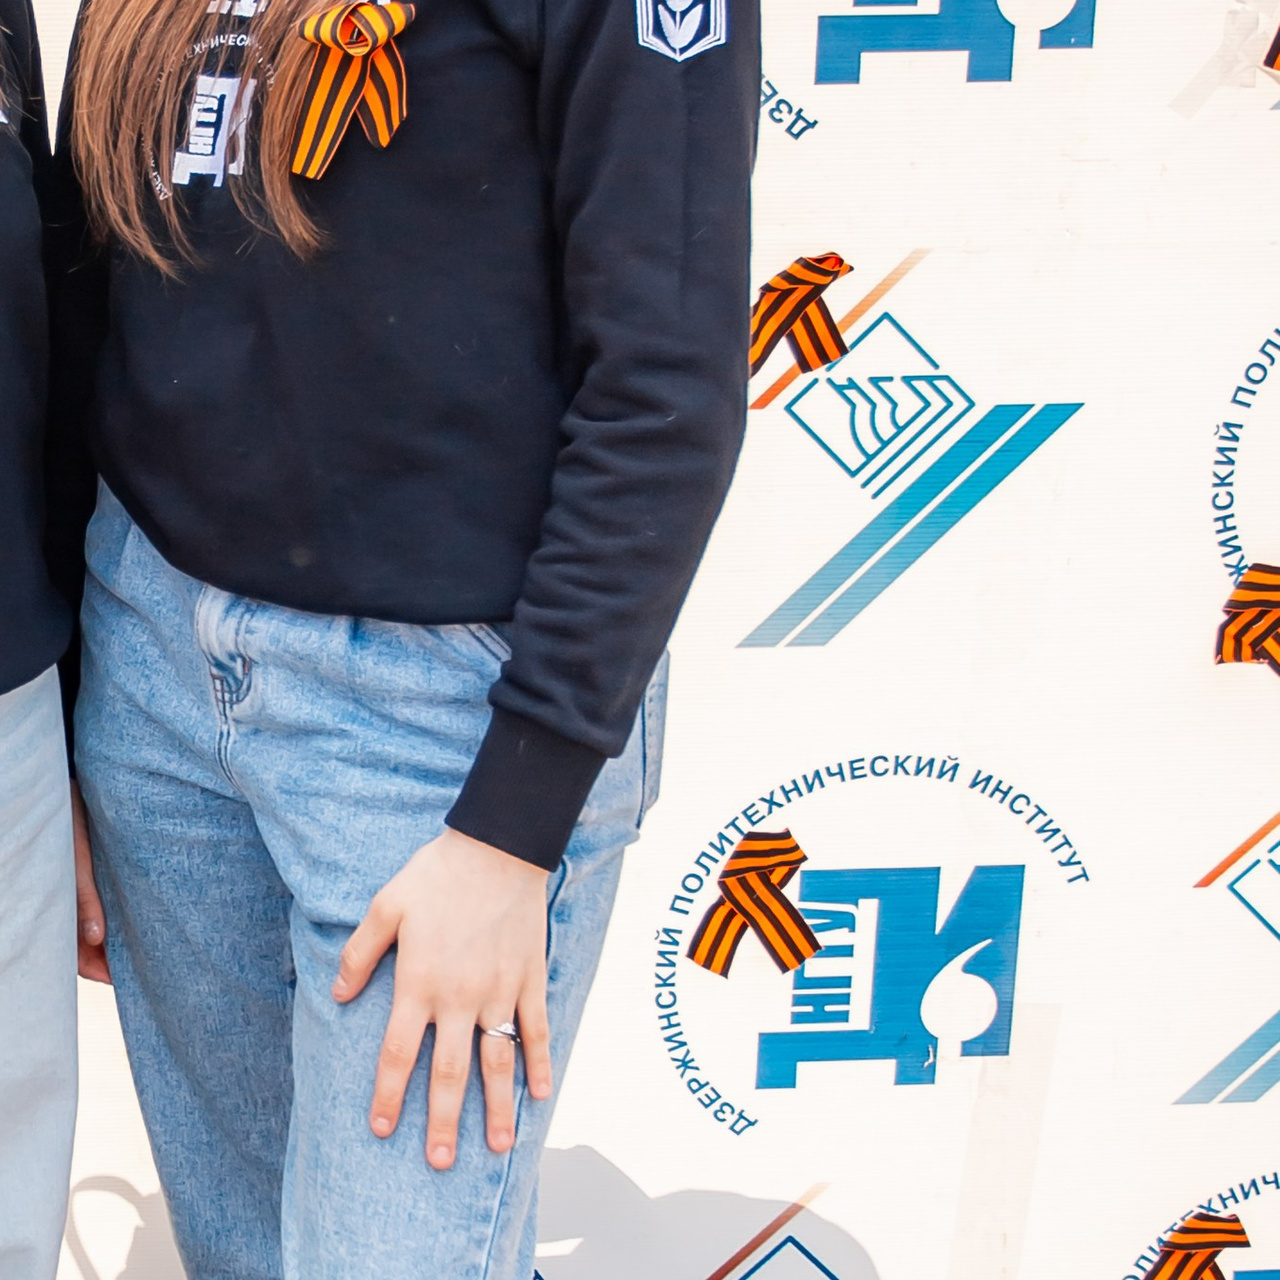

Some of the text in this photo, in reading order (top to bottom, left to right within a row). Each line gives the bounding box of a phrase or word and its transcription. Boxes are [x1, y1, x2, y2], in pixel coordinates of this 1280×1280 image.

[654, 753, 1090, 1136] ДЗЕРЖИНСКИЙ ПОЛИТЕХНИЧЕСКИЙ ИНСТИТУТ
